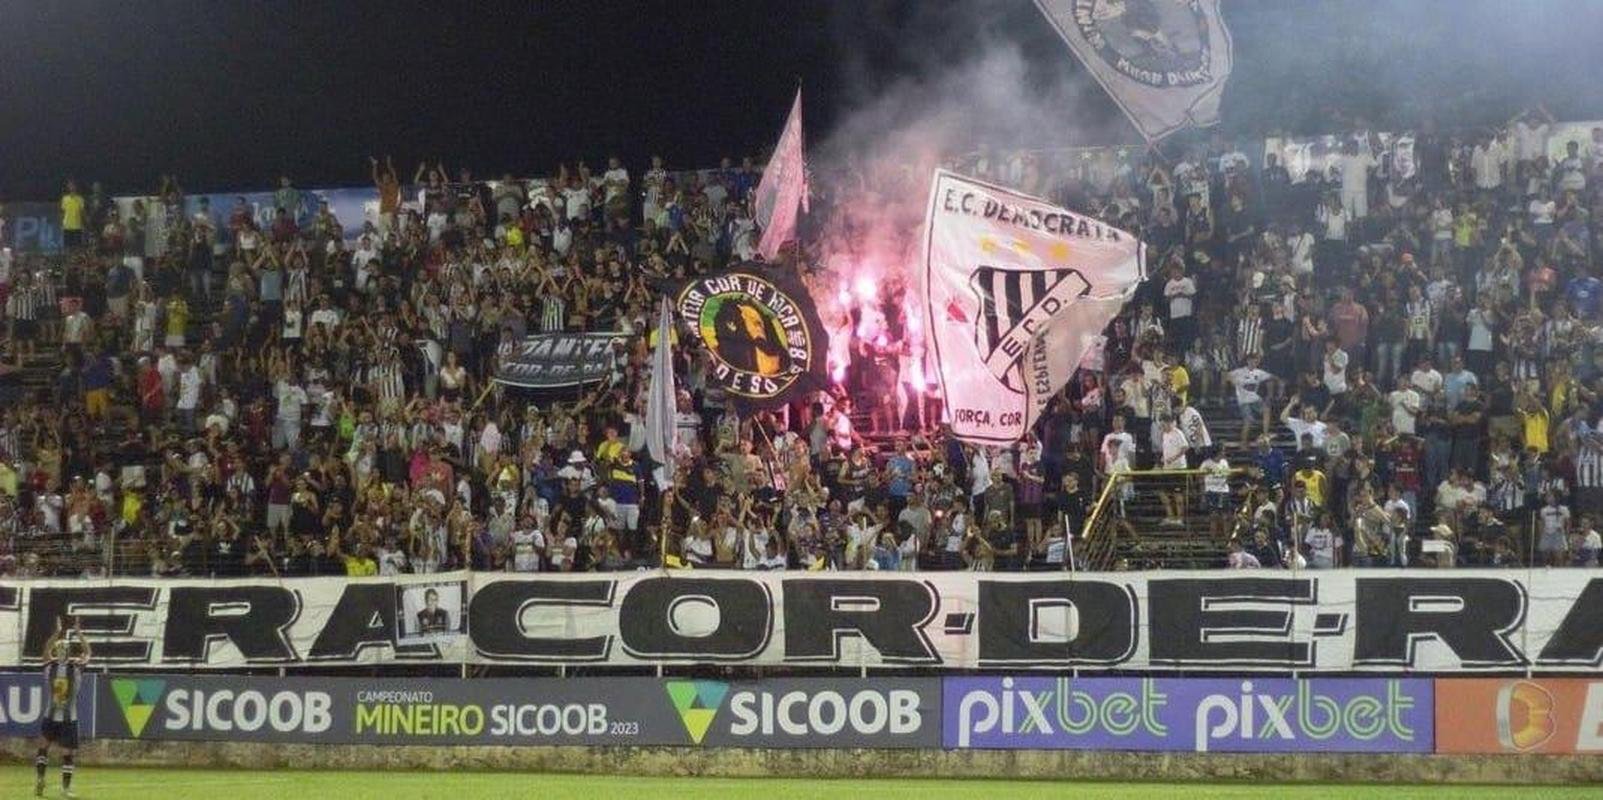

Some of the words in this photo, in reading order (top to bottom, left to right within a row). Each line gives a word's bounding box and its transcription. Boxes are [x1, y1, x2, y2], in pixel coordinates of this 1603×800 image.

[1000, 411, 1022, 426] COR
[0, 584, 443, 664] ERA
[165, 689, 333, 733] SICOOB
[355, 703, 485, 735] MINEIRO
[490, 703, 608, 735] SICOOB
[610, 722, 639, 735] 2023
[356, 690, 434, 703] CAMPEONATO
[729, 689, 922, 736] SICOOB
[958, 676, 1168, 748] pixbet
[1195, 678, 1415, 752] pixbet
